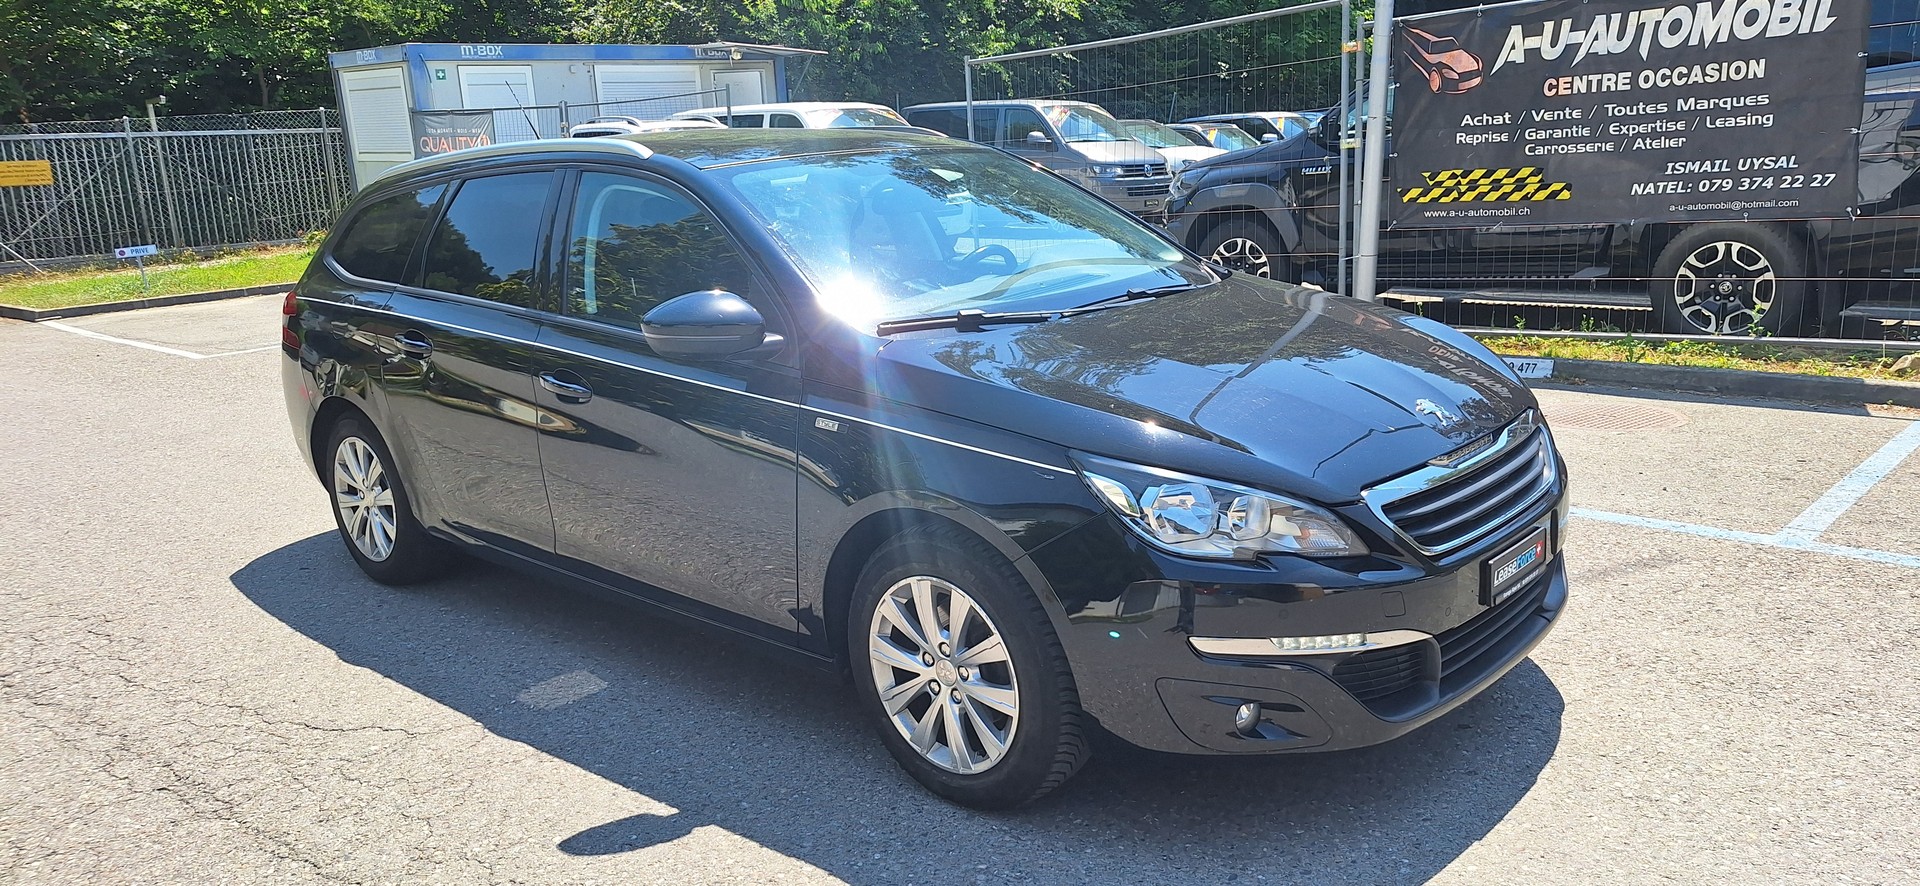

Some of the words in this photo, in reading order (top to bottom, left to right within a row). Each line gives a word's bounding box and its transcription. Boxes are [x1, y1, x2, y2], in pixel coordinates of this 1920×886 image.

[1490, 0, 1837, 77] A-U-AUTOMOBIL
[1543, 72, 1632, 97] CENTRE
[1638, 59, 1766, 90] OCCASION
[1461, 112, 1512, 126] Achat
[1531, 107, 1582, 122] Vente
[1604, 102, 1668, 116] Toutes
[1677, 94, 1769, 112] Marques
[1456, 131, 1509, 146] Reprise
[1525, 125, 1591, 140] Garantie
[1609, 120, 1686, 137] Expertise
[1706, 113, 1774, 128] Leasing
[1525, 142, 1615, 156] Carrosserie
[1632, 136, 1686, 150] Atelier
[1665, 159, 1731, 175] ISMAIL
[1737, 156, 1799, 171] UYSAL
[1630, 181, 1692, 196] NATEL:
[1698, 178, 1733, 192] 079
[1737, 177, 1774, 191] 374
[1779, 175, 1805, 189] 22
[1809, 173, 1836, 188] 27
[1424, 207, 1531, 218] www.a-u-automobil.ch
[1669, 199, 1799, 212] a-u-automobil@hotmail.com
[1517, 362, 1538, 374] 477
